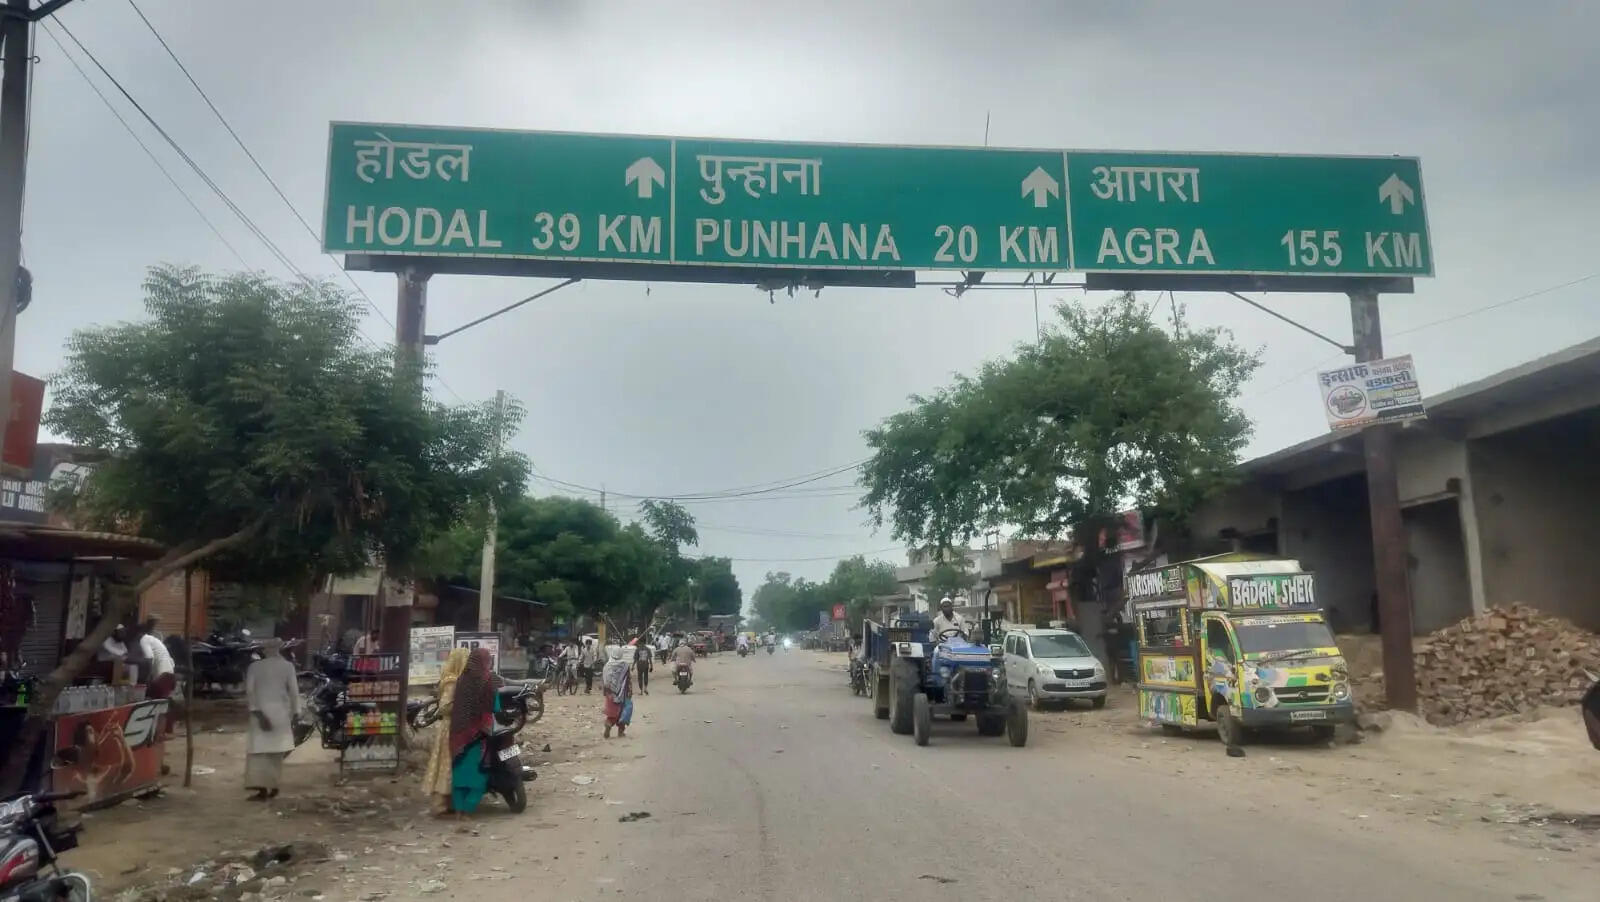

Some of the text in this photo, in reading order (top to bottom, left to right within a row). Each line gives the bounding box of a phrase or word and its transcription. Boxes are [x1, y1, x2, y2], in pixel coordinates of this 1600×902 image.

[354, 132, 473, 184] होडल
[696, 154, 822, 205] पुन्हाना
[1090, 166, 1200, 203] आगरा
[346, 204, 662, 254] HODAL 39 KM
[696, 218, 1058, 263] PUNHANA 20 KM
[1096, 227, 1424, 268] AGRA 155 KM
[1232, 579, 1277, 609] BADAM
